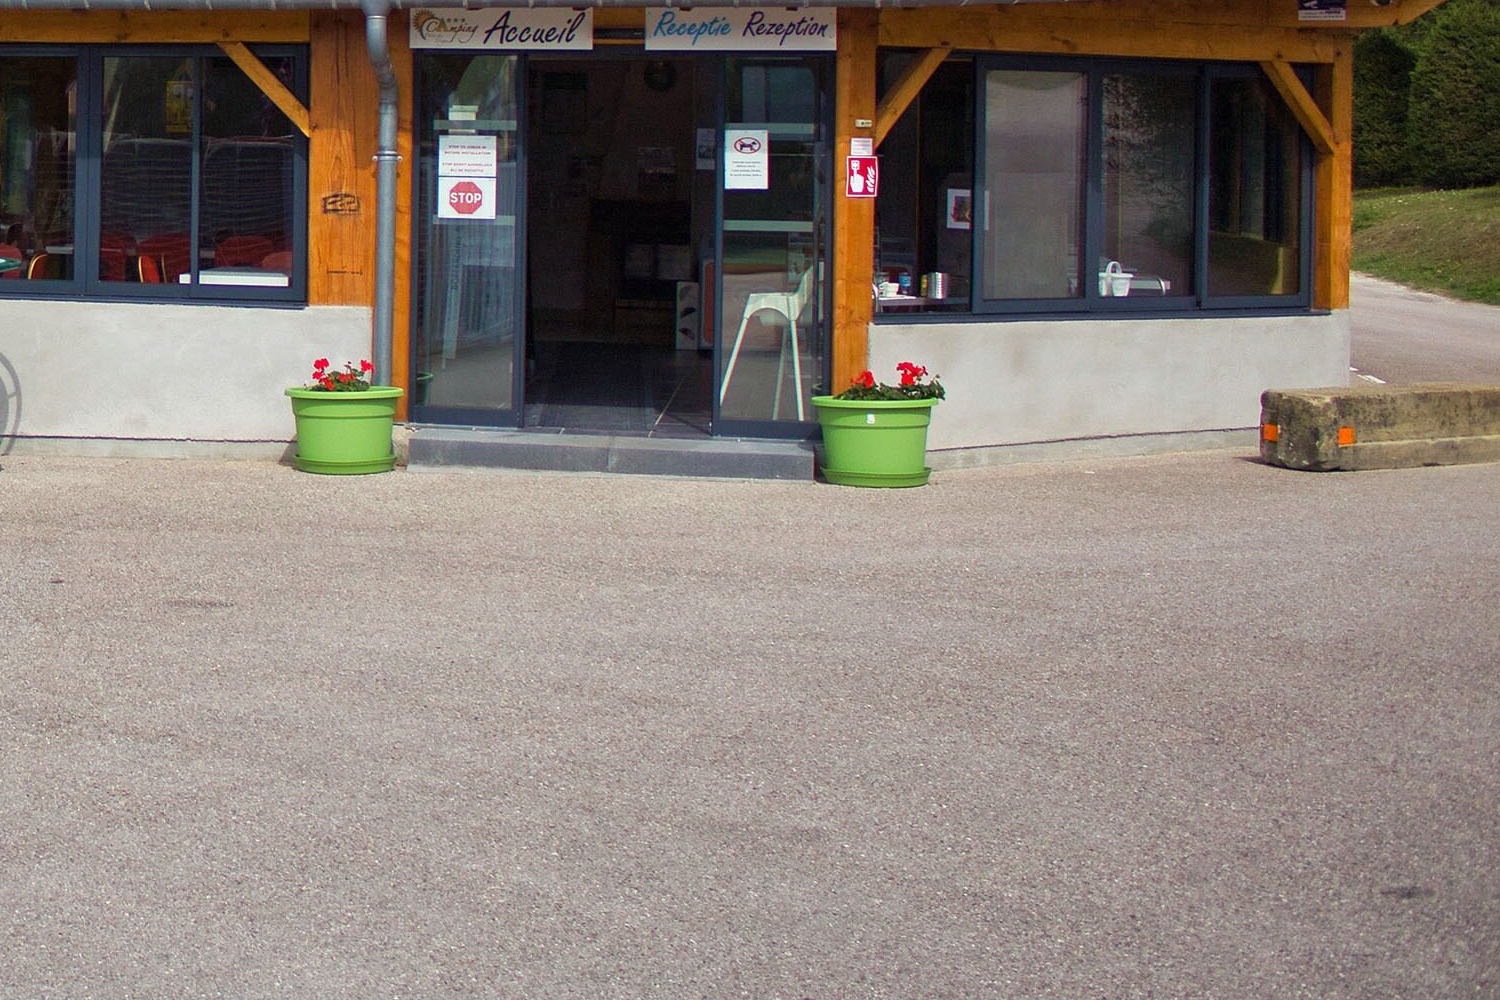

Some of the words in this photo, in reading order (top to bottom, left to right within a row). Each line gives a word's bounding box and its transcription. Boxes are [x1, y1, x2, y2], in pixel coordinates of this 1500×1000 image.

[483, 10, 586, 44] Accueil
[653, 11, 732, 46] Receptie
[742, 11, 829, 46] Rezeption
[450, 192, 482, 204] STOP
